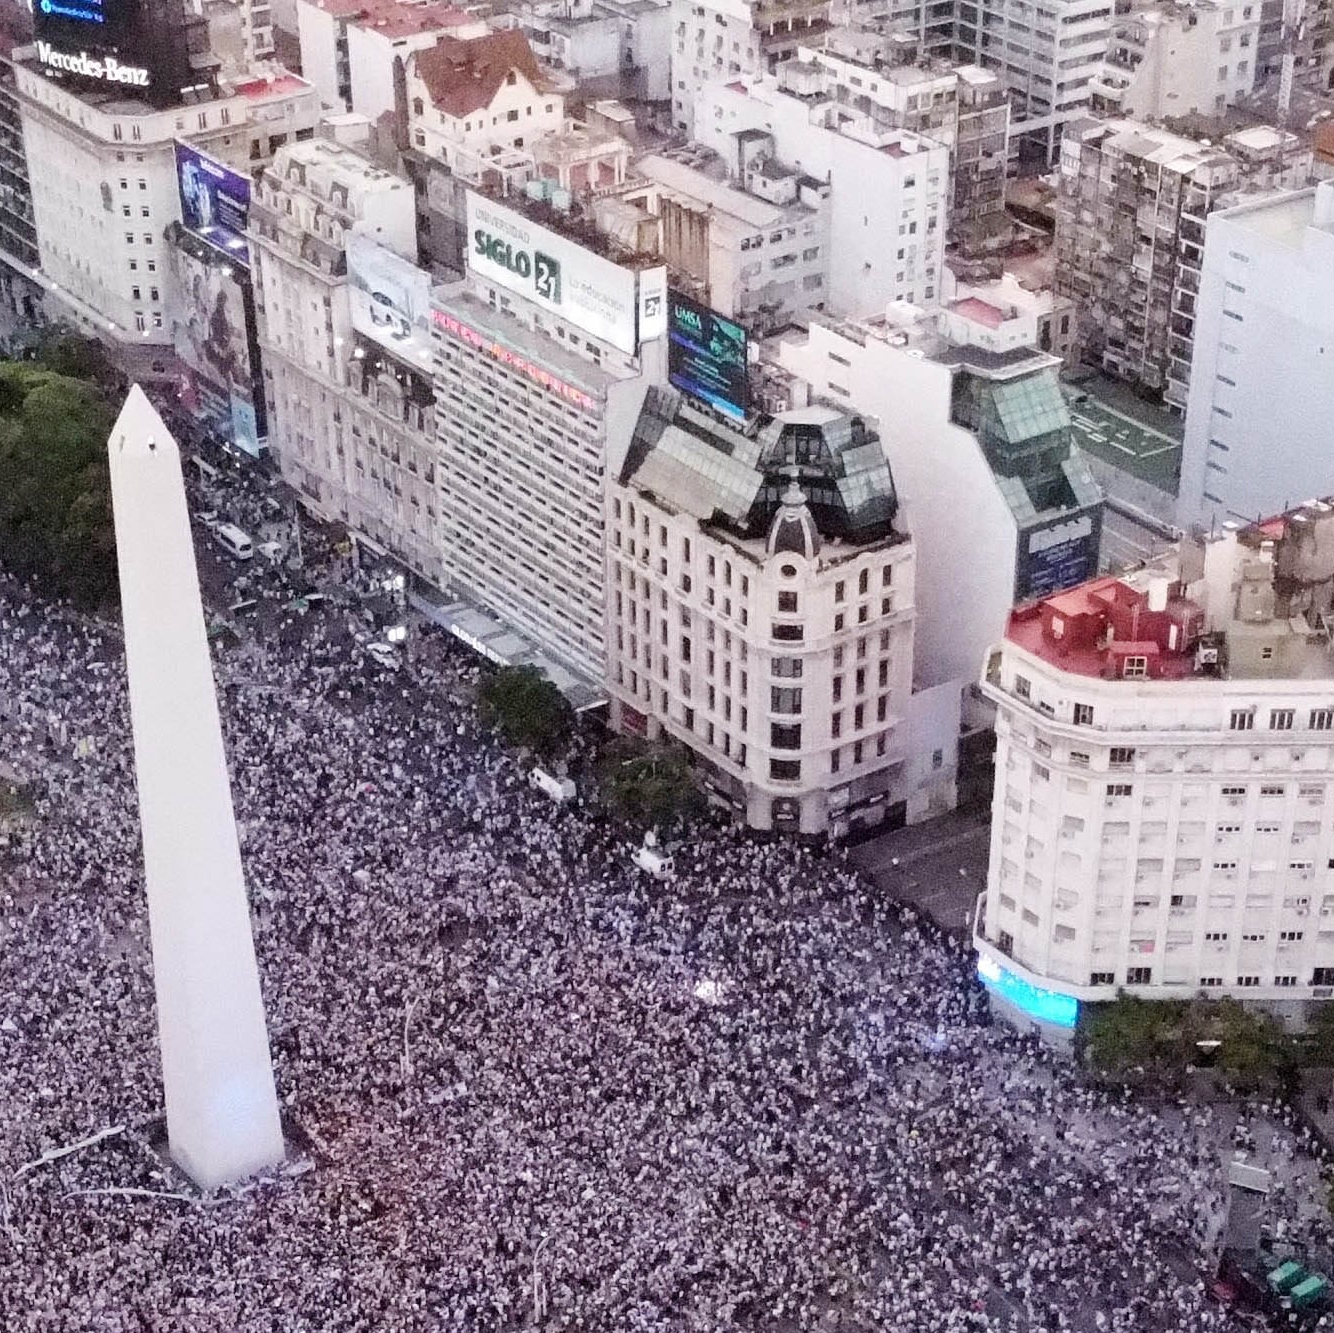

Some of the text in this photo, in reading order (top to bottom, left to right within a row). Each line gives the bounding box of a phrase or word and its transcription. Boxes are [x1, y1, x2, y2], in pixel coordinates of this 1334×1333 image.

[33, 40, 149, 85] Mercedes-Benz
[474, 229, 558, 303] SIGLO 21
[674, 304, 702, 330] UMSA
